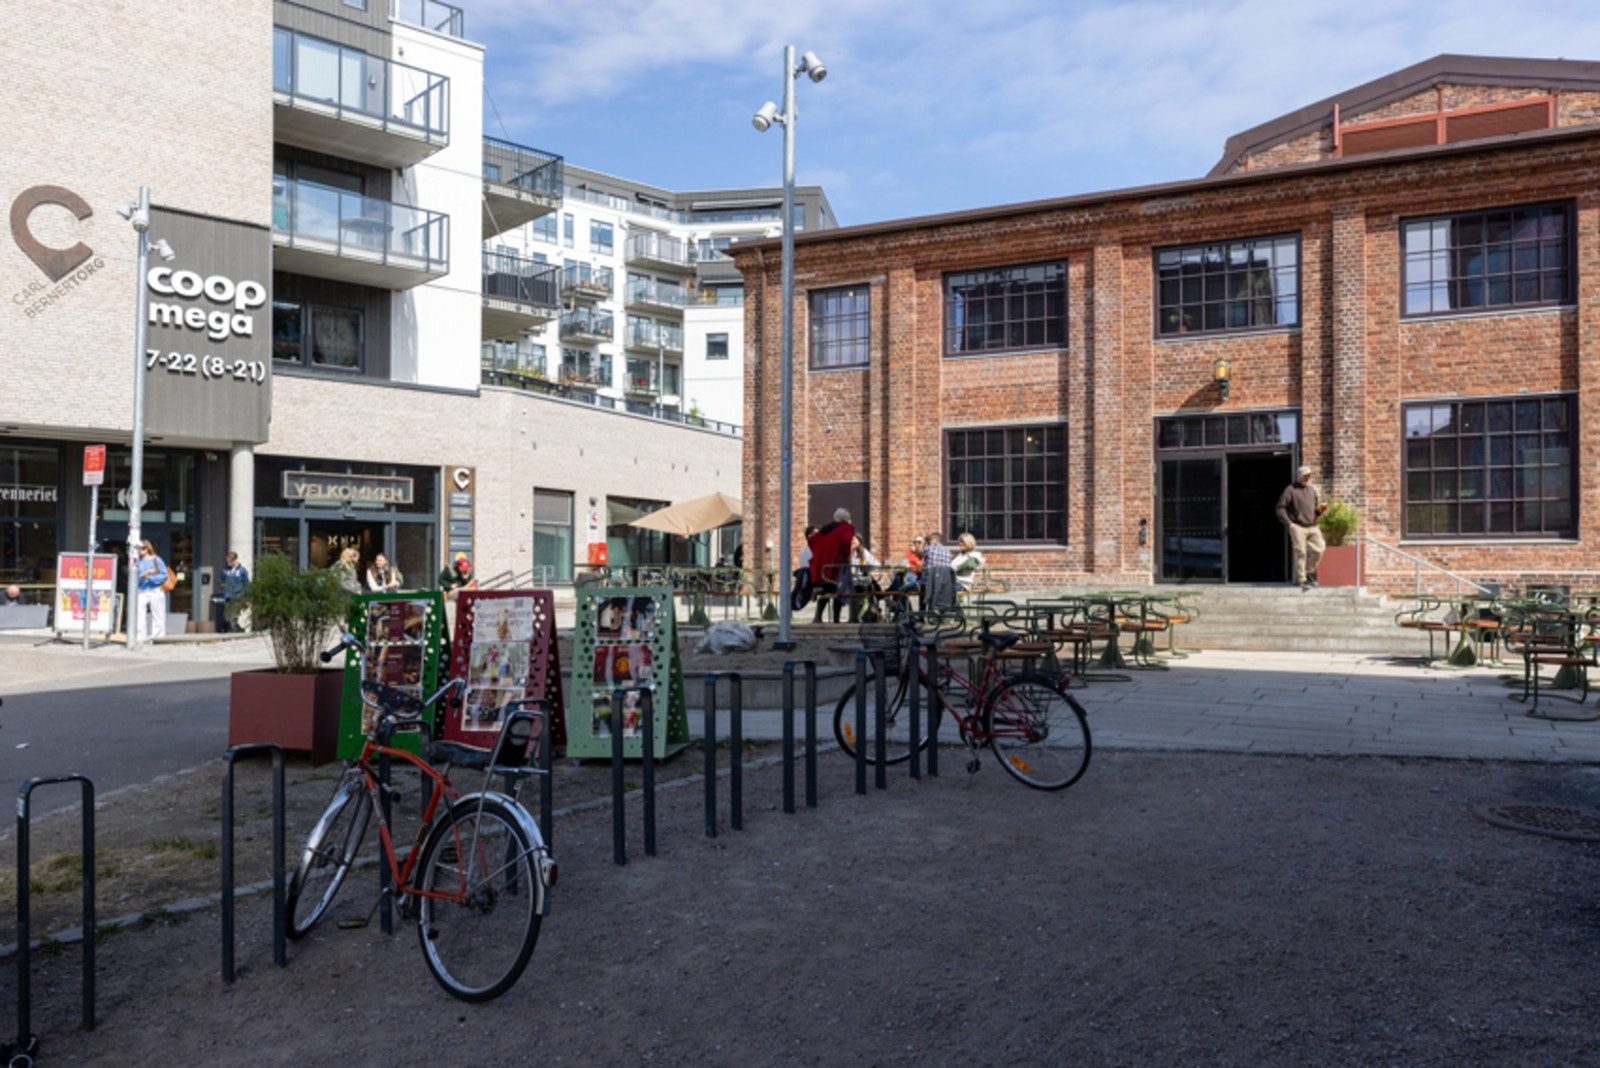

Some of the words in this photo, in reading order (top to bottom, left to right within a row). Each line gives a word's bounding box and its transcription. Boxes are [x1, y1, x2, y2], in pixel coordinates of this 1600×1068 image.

[12, 279, 47, 306] CARL
[147, 266, 267, 310] coop
[149, 301, 253, 340] mega
[146, 348, 197, 373] 7-22
[202, 354, 266, 381] (8-21)
[294, 483, 404, 501] VELKOMMEN
